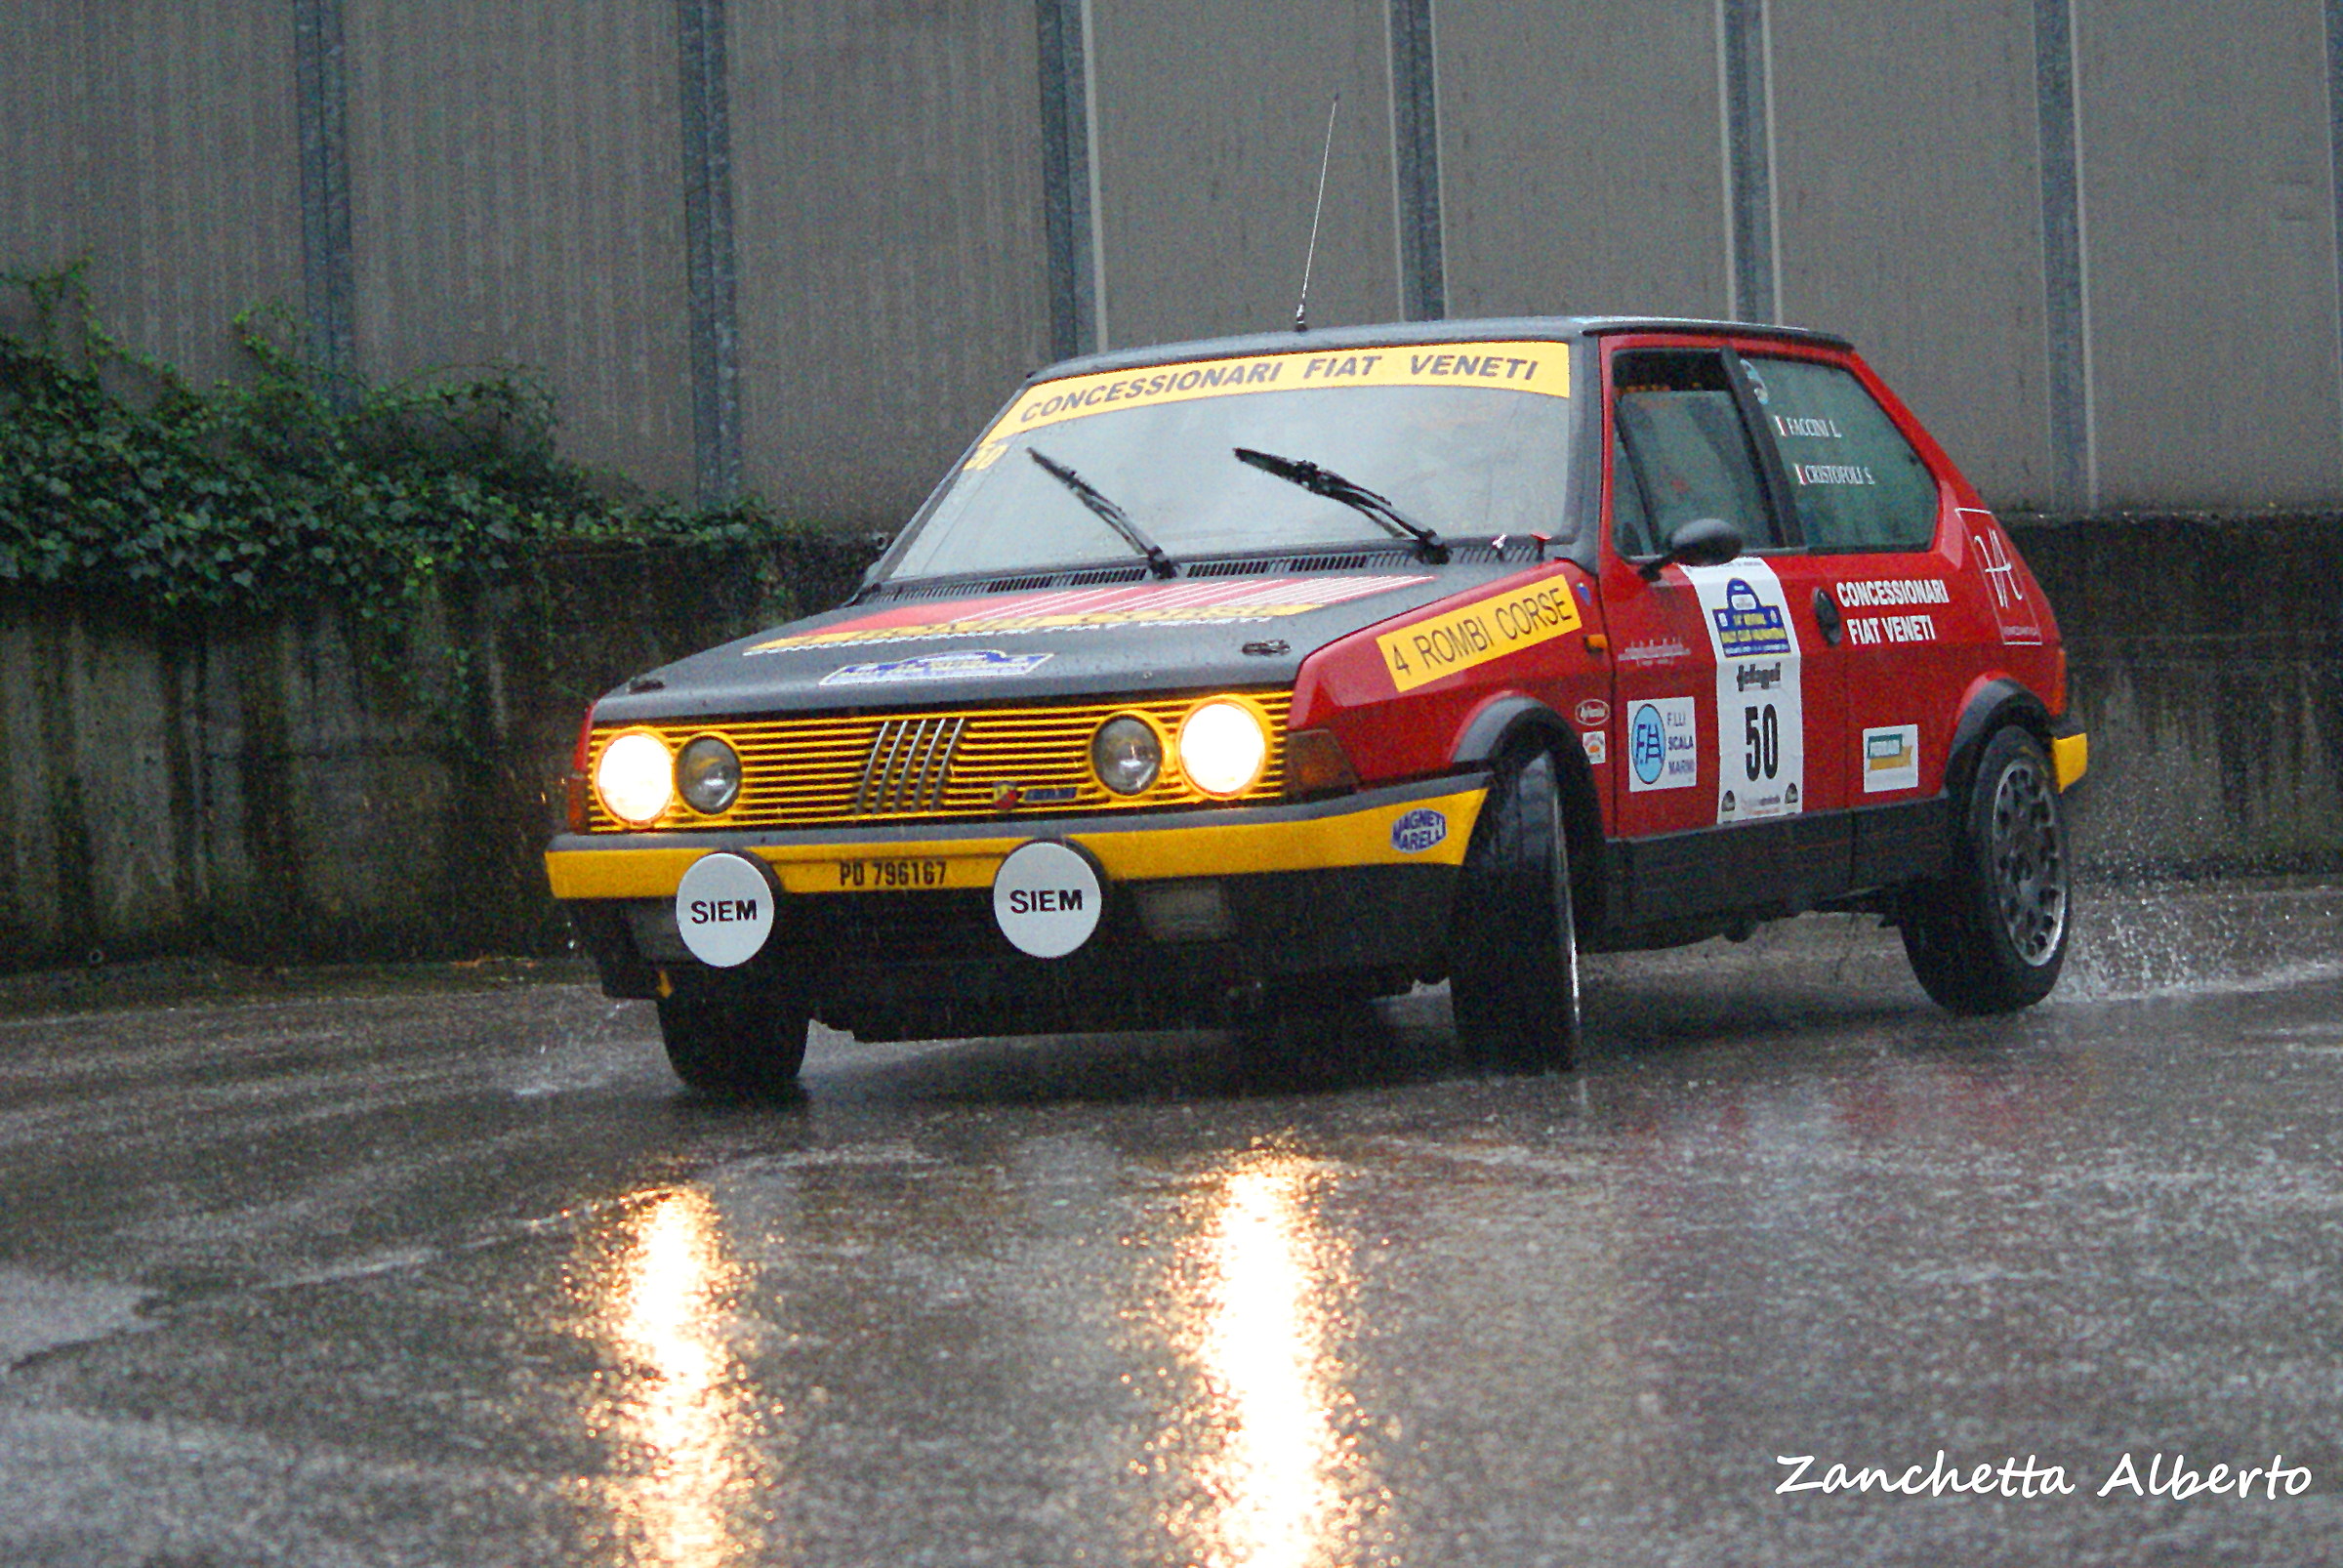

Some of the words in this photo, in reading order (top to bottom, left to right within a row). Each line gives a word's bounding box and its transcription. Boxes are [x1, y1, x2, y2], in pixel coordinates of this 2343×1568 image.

[1020, 361, 1283, 423] CONCESSIONARI
[1302, 355, 1381, 379] FIAT
[1410, 354, 1540, 381] VENETI
[1835, 579, 1950, 607] CONCESSIONARI
[1392, 643, 1412, 676] 4
[1413, 616, 1495, 670] ROMBI
[1495, 587, 1573, 640] CORSE
[1846, 617, 1881, 645] FIAT
[1880, 614, 1936, 642] VENETI
[1745, 703, 1778, 781] 50
[840, 862, 865, 886] PD
[873, 860, 947, 886] 796167
[690, 899, 758, 925] SIEM
[1009, 888, 1084, 915] SIEM
